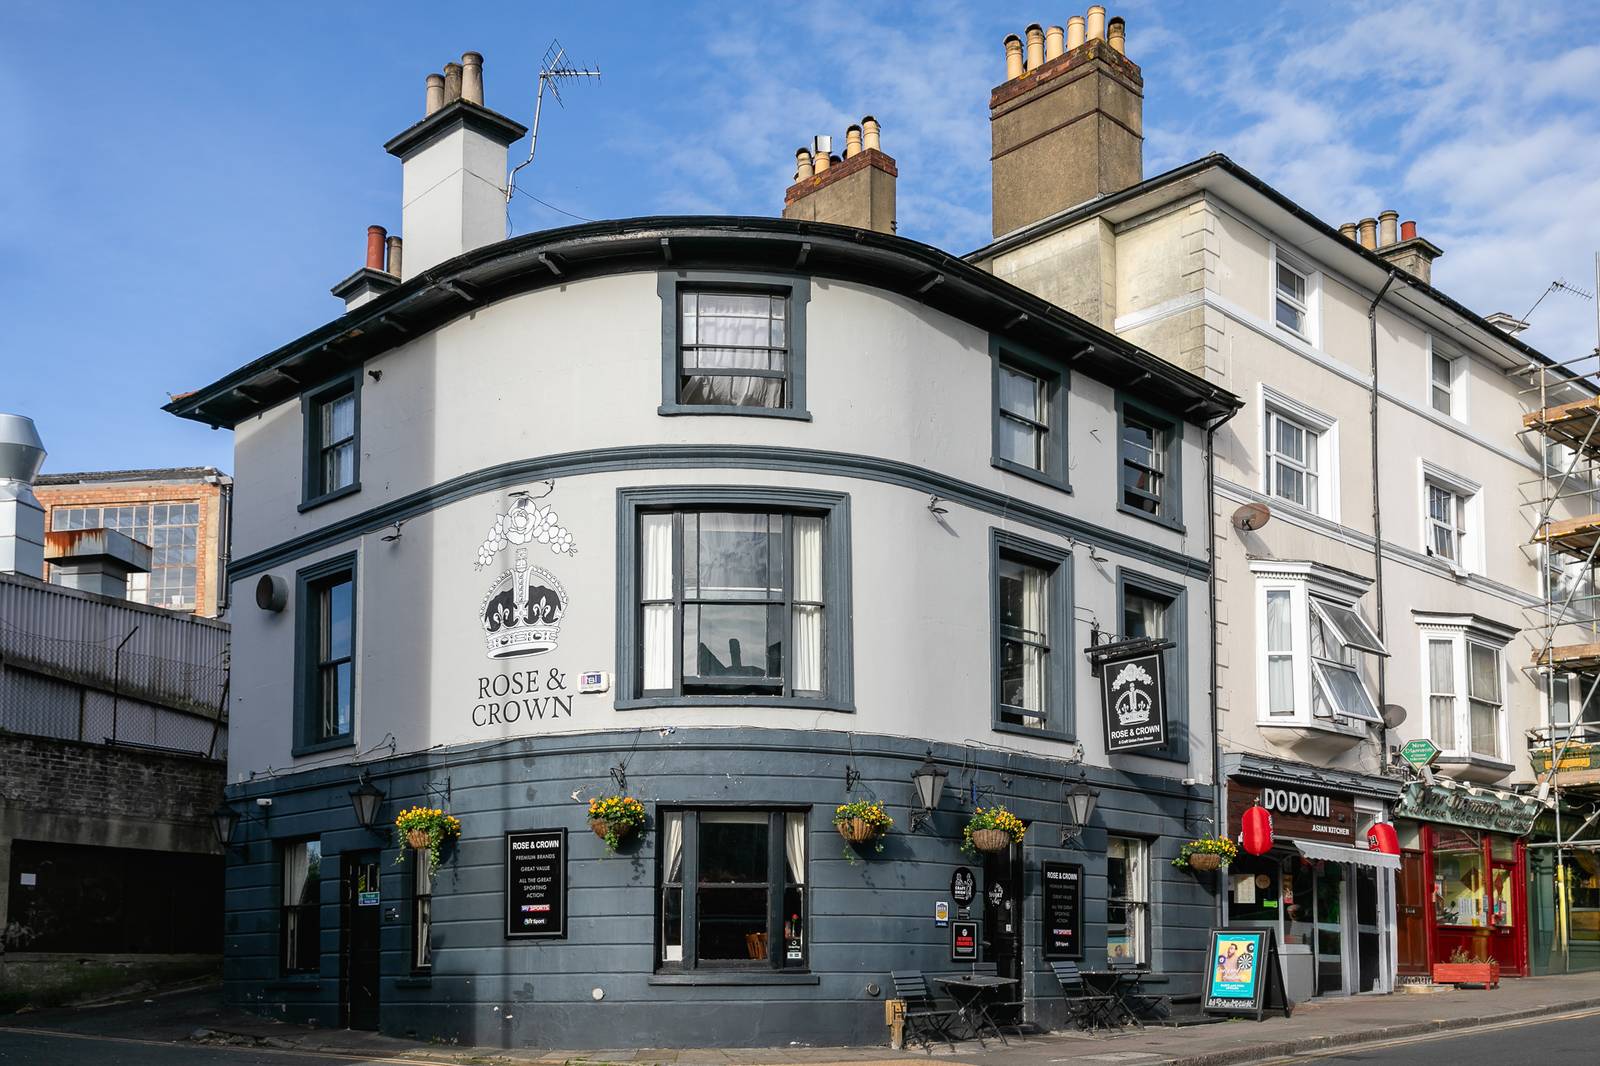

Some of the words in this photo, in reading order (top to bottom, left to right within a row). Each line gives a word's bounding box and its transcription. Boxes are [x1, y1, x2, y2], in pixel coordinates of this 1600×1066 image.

[478, 670, 539, 699] ROSE
[546, 667, 567, 691] &
[472, 695, 574, 727] CROWN
[1111, 729, 1129, 739] ROSE
[1129, 728, 1135, 737] &
[1135, 724, 1160, 735] CROWN
[1264, 788, 1330, 818] DODOMI
[1312, 824, 1328, 833] ASIAN
[1328, 826, 1350, 836] KITCHEN
[512, 841, 530, 850] ROSE
[530, 841, 535, 849] &
[536, 840, 559, 849] CROWN
[1046, 871, 1059, 880] ROSE
[1062, 872, 1078, 881] CROWN
